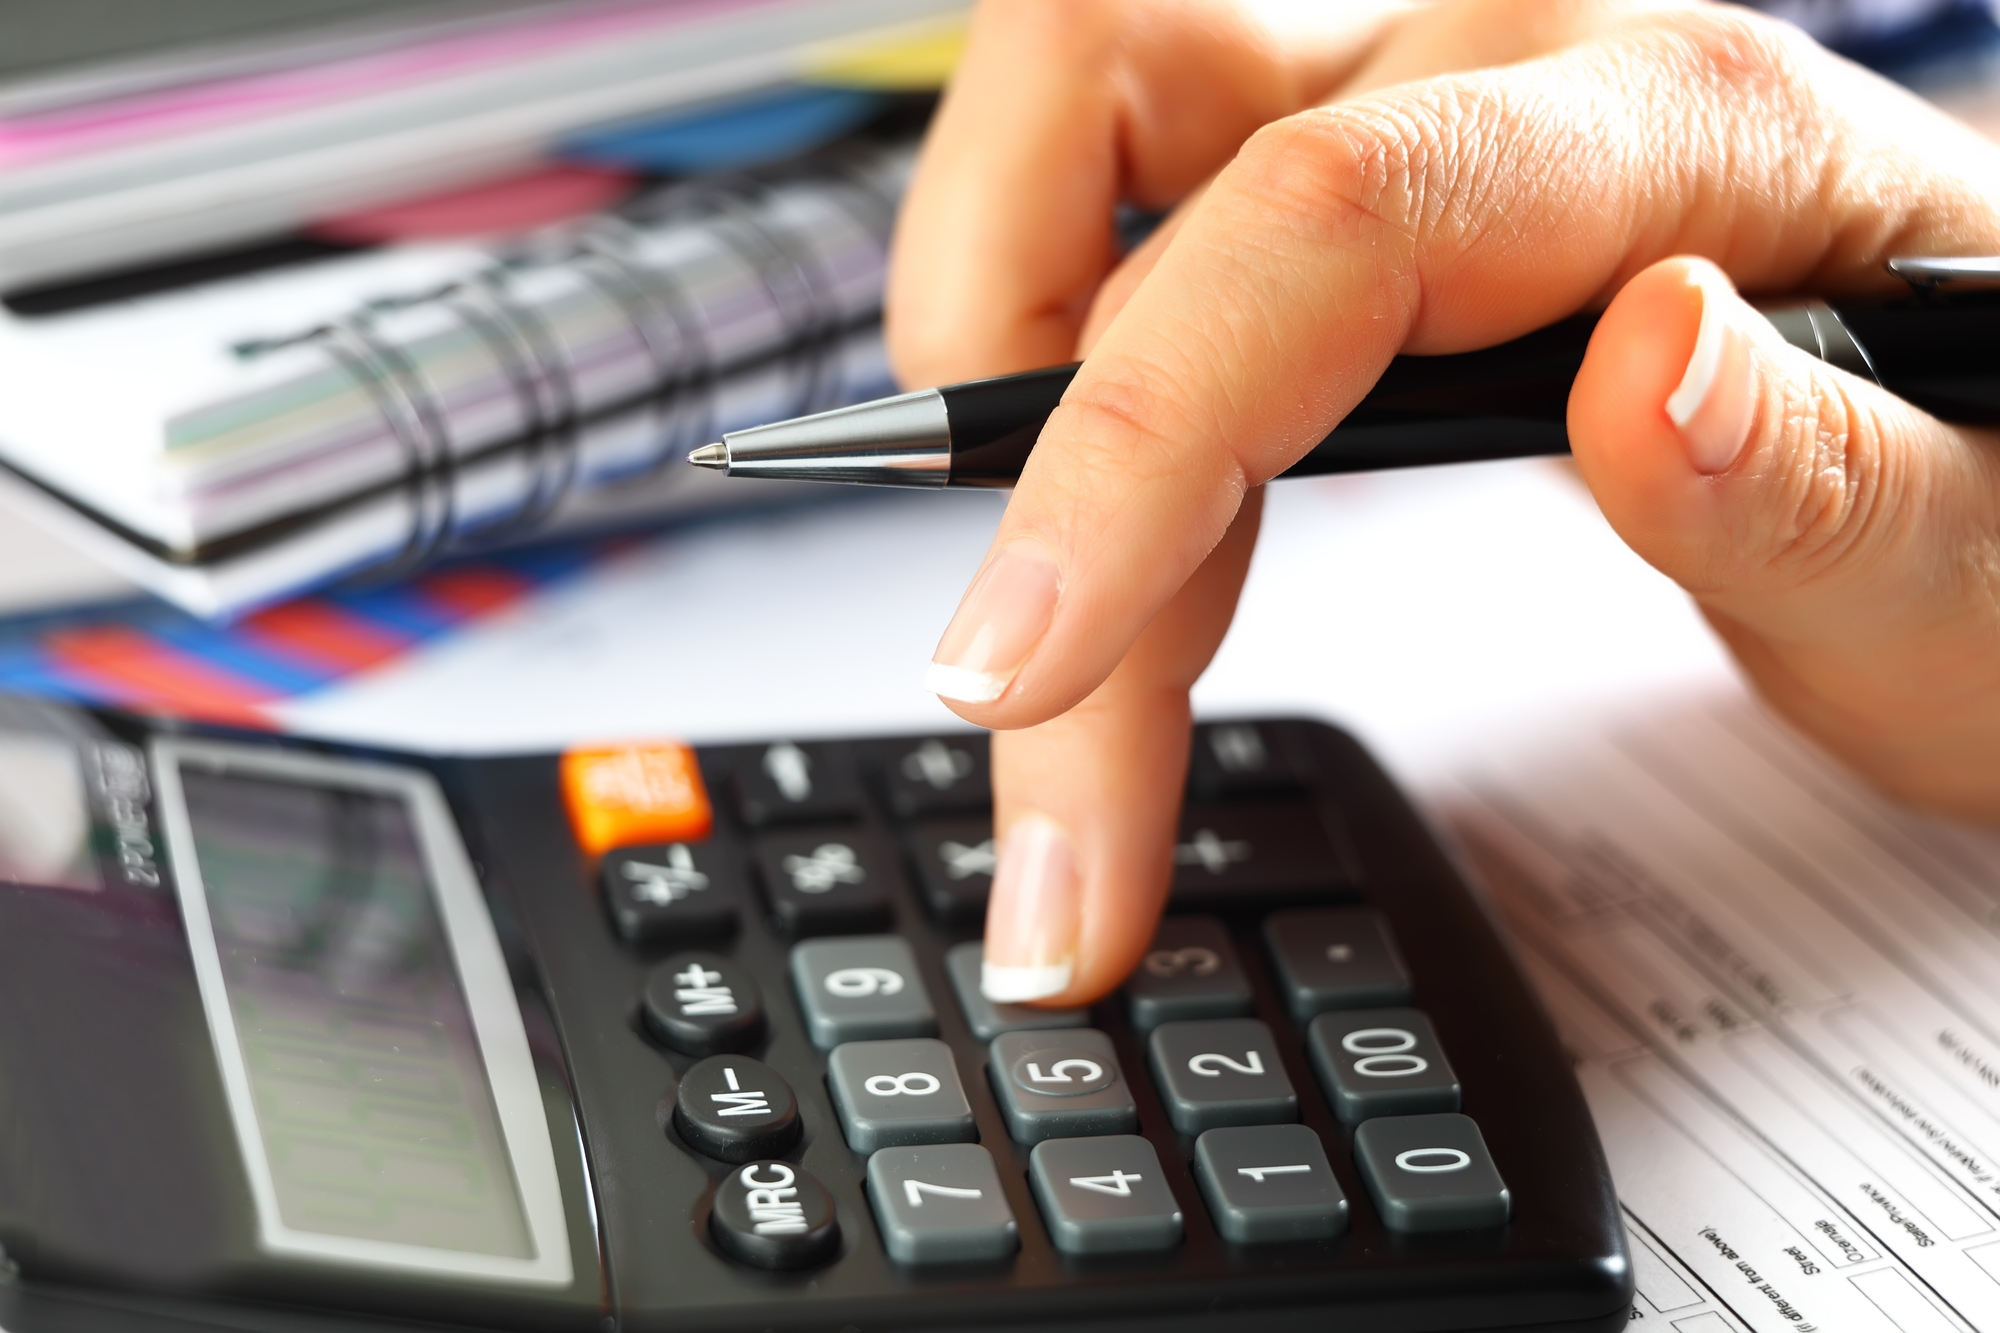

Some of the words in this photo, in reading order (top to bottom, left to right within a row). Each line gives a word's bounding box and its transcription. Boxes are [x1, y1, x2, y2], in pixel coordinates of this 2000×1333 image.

[1144, 945, 1221, 978] 3
[673, 962, 739, 1016] M+
[823, 966, 905, 998] 9
[1187, 1050, 1266, 1077] 2
[1341, 1027, 1429, 1078] 00
[863, 1071, 941, 1097] 8
[1026, 1057, 1104, 1083] 5
[710, 1066, 773, 1118] M-
[1237, 1164, 1312, 1182] 1
[1395, 1147, 1472, 1172] 0
[903, 1178, 983, 1208] 7
[1069, 1169, 1143, 1196] 4
[740, 1162, 810, 1236] MRC
[1735, 1260, 1764, 1285] from
[1782, 1245, 1821, 1276] Street
[1755, 1283, 1803, 1322] different
